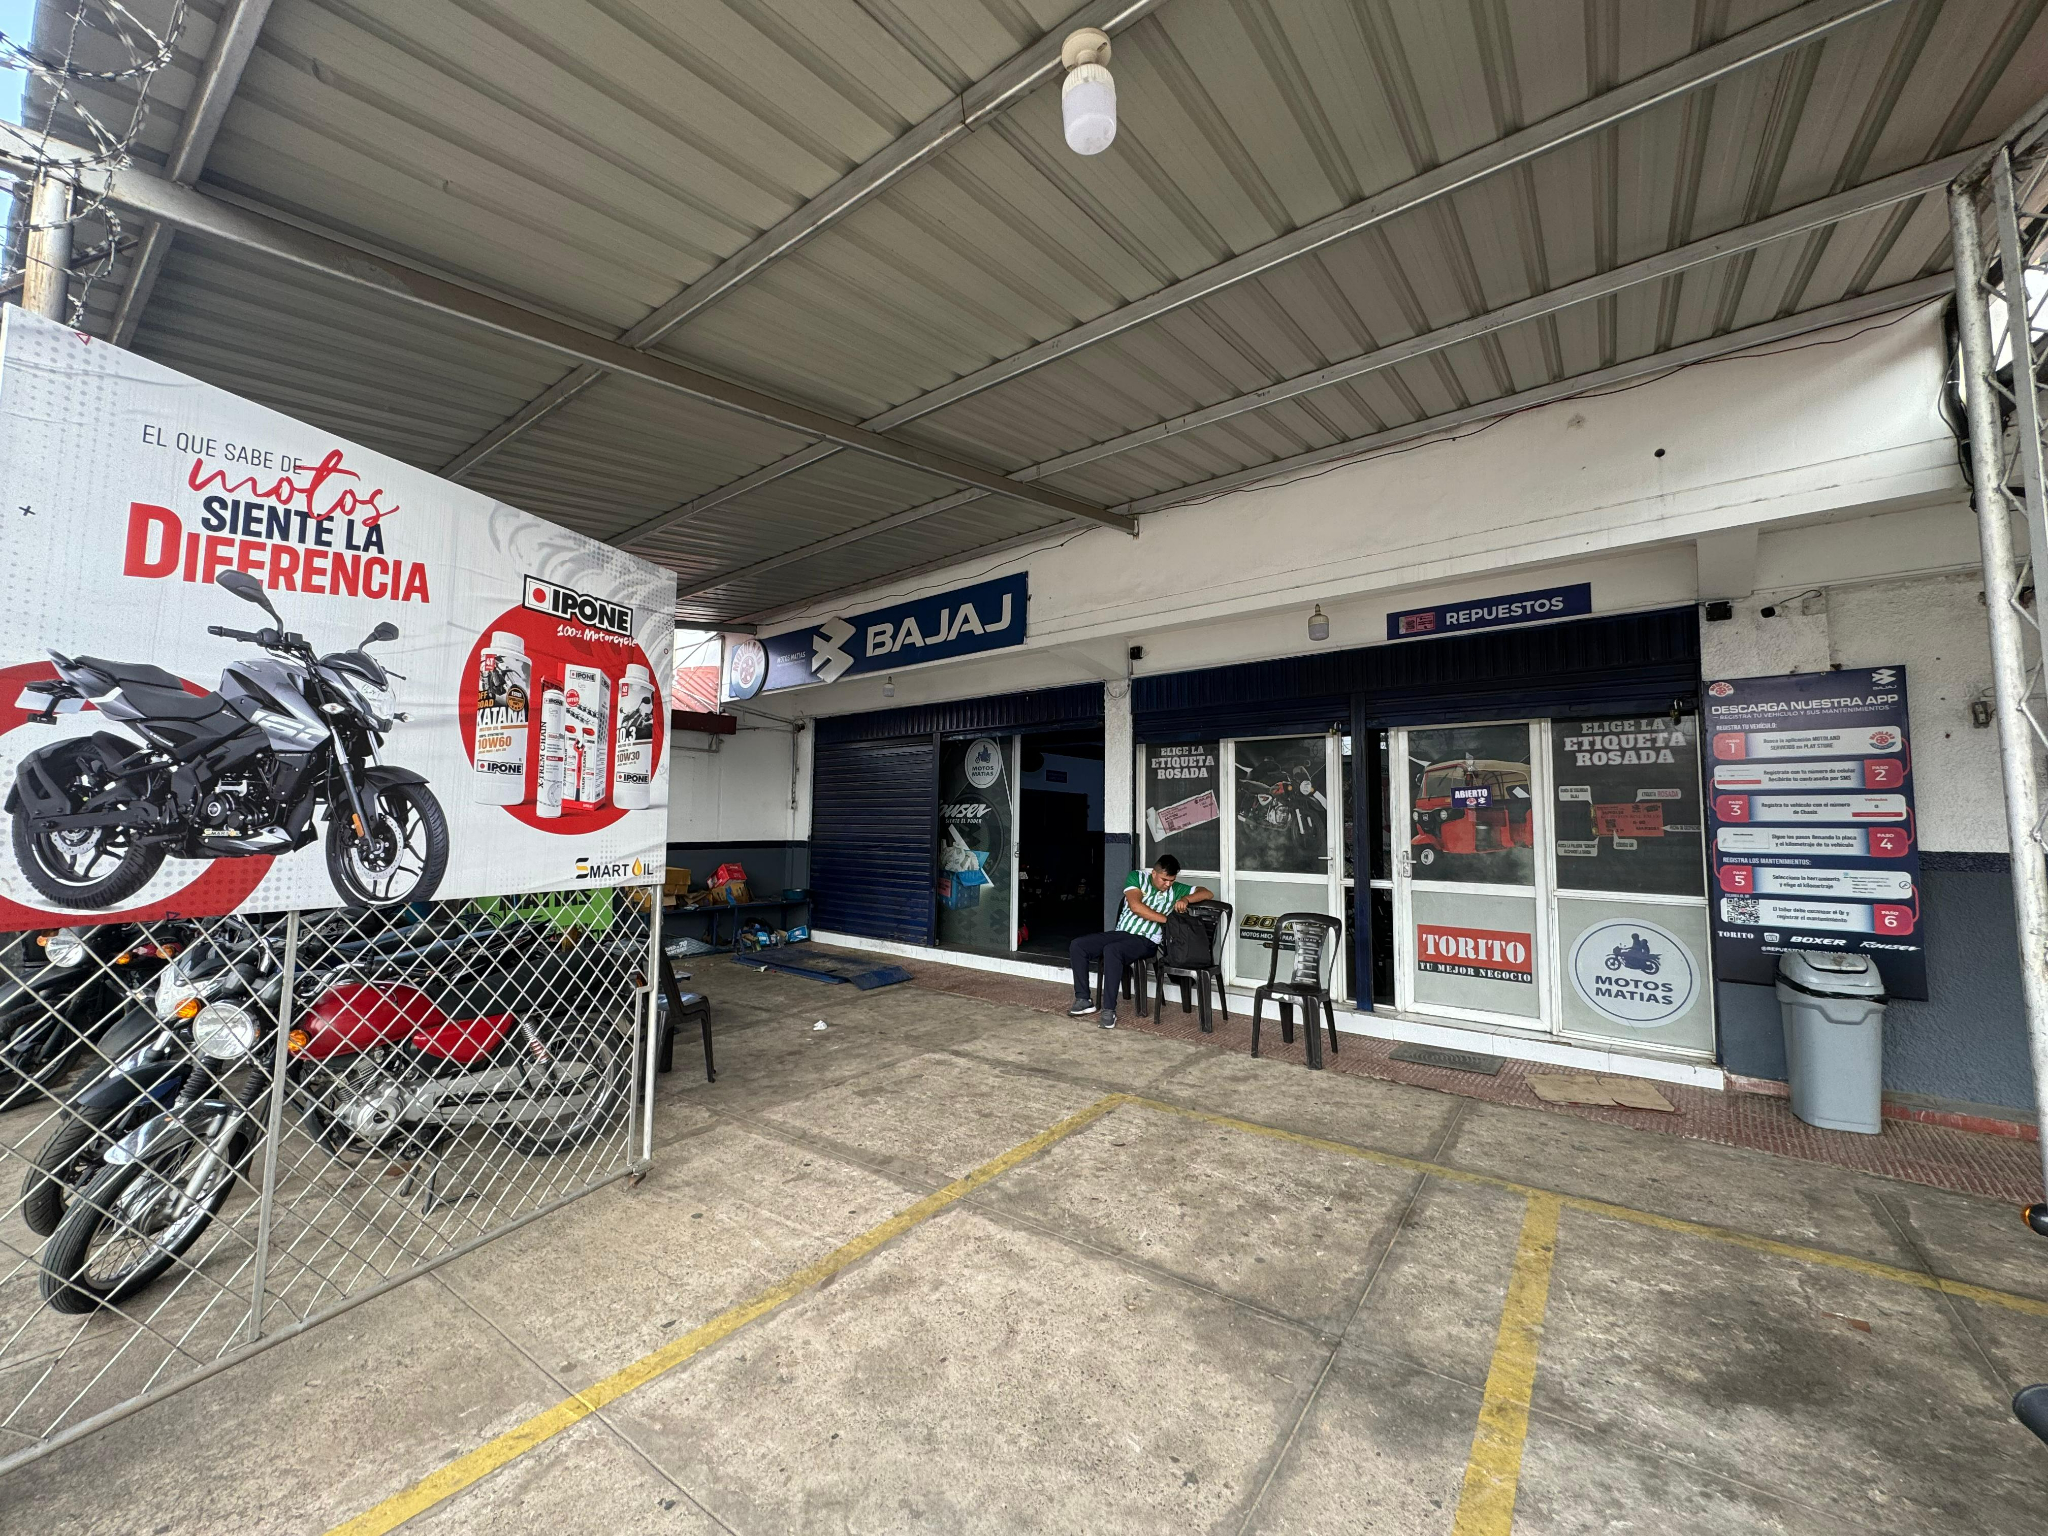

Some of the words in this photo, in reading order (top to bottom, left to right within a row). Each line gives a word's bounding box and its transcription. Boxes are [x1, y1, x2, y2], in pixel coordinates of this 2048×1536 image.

[142, 424, 167, 448] EL
[176, 432, 217, 458] QUE
[224, 443, 273, 470] SABE
[281, 455, 302, 476] DE
[188, 449, 399, 528] motos
[201, 495, 334, 548] SIENTE
[345, 518, 384, 555] LA
[123, 501, 430, 604] DIFERENCIA
[552, 589, 630, 634] IPONE
[1445, 596, 1564, 626] REPUESTOS
[866, 592, 1012, 658] BAJAJ
[556, 624, 583, 638] 100%
[583, 628, 638, 648] Motorcycle
[575, 671, 596, 682] IPONE
[1711, 702, 1789, 715] DESCARGA
[1790, 697, 1863, 710] NUESTRA
[1865, 694, 1898, 705] APP
[1822, 704, 1889, 714] MANTENIMIENTOS
[1581, 720, 1635, 734] ELIGE
[1640, 718, 1666, 731] LA
[478, 735, 512, 750] 10W60
[1563, 731, 1687, 751] ETIQUETA
[1728, 743, 1735, 754] 1
[616, 750, 640, 763] 10W30
[1160, 747, 1189, 756] ELIGE
[1191, 745, 1205, 755] LA
[1575, 749, 1675, 766] ROSADA
[487, 762, 522, 774] IPONE
[1151, 755, 1215, 768] ETIQUETA
[623, 773, 648, 784] IPONE
[1157, 767, 1208, 780] ROSADA
[1874, 770, 1887, 781] 2
[1454, 788, 1488, 799] ABIERTO
[1730, 805, 1741, 816] 3
[1880, 838, 1893, 850] 4
[575, 857, 630, 879] SMART
[1734, 875, 1745, 886] 5
[1884, 915, 1898, 927] 6
[1717, 930, 1754, 939] TORITO
[1790, 935, 1847, 946] BOXER
[1422, 933, 1526, 964] TORITO
[1419, 962, 1433, 971] TU
[1437, 964, 1475, 976] MEJOR
[1479, 968, 1532, 982] NEGOCIO
[1595, 975, 1674, 993] MOTOS
[1595, 987, 1674, 1005] MATIAS
